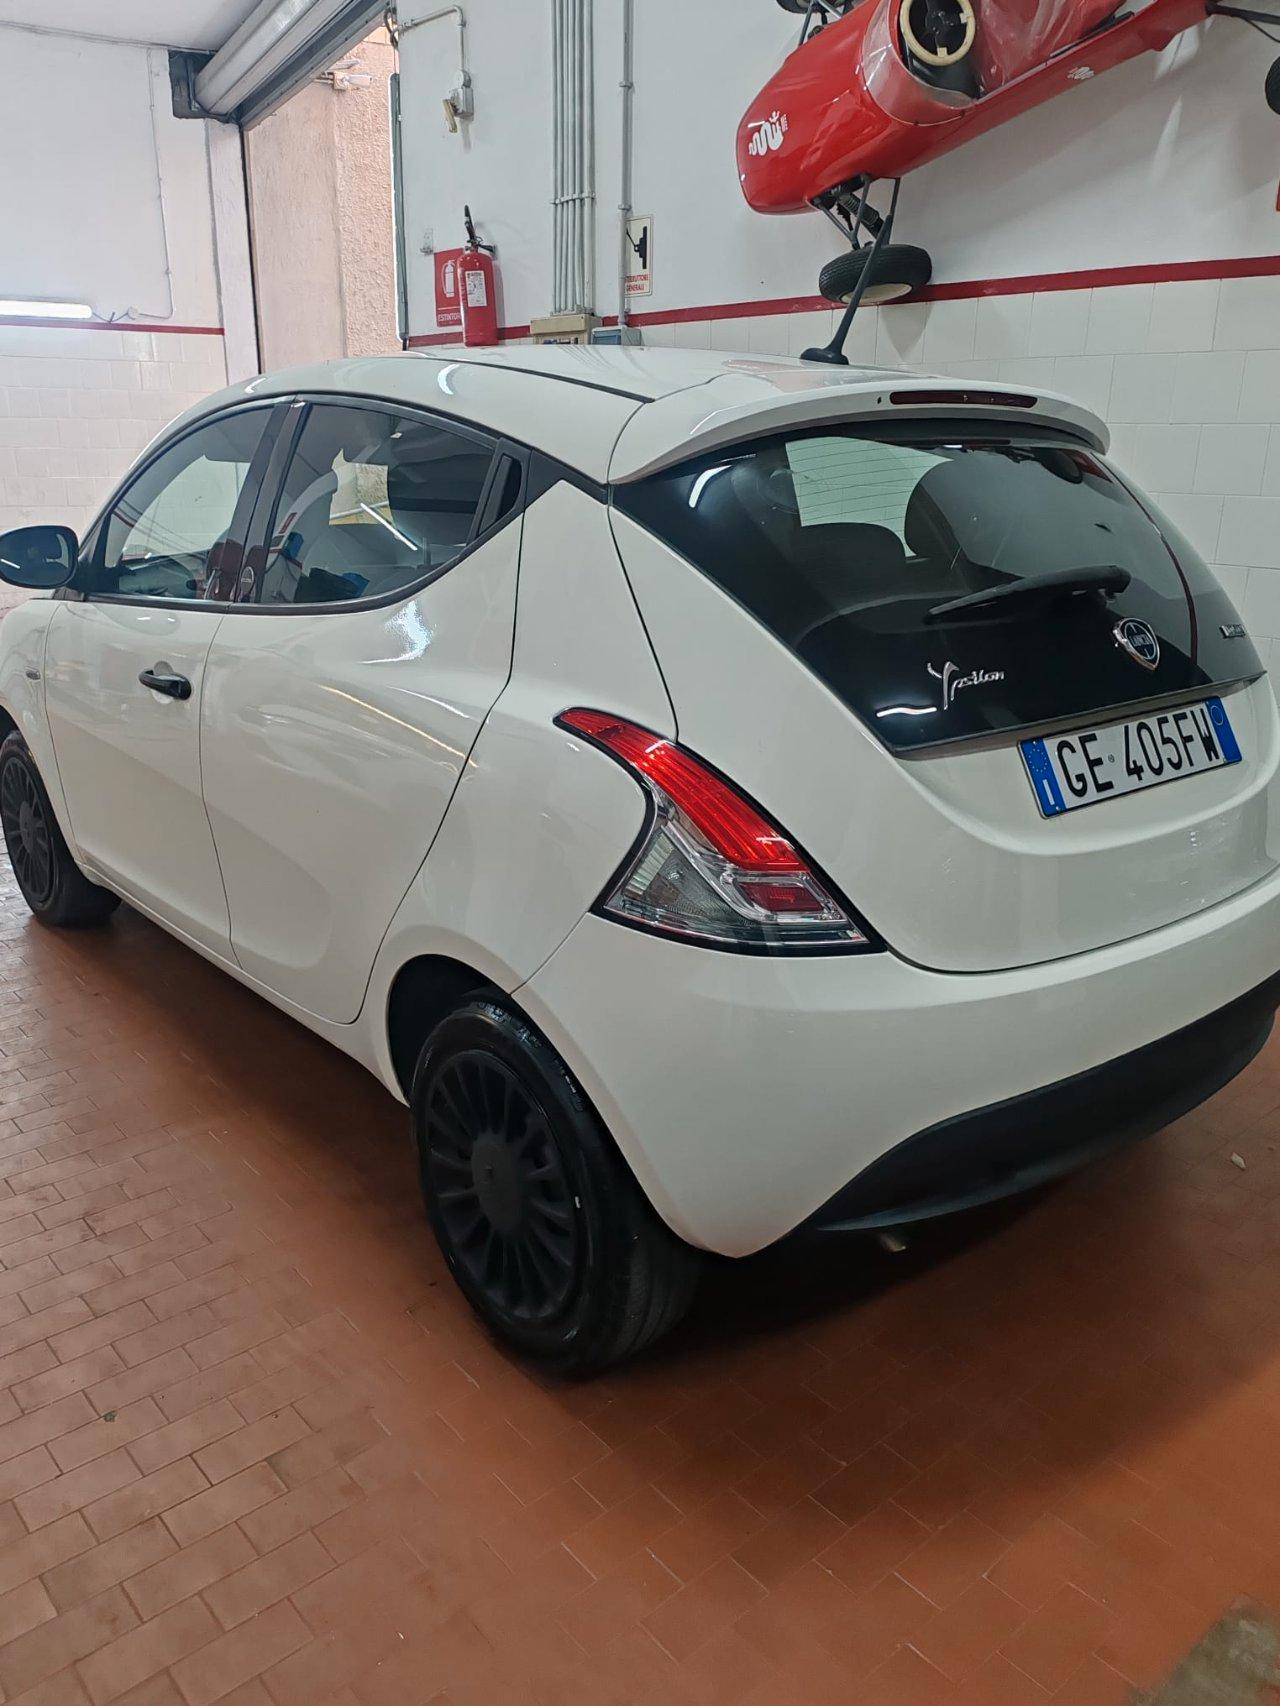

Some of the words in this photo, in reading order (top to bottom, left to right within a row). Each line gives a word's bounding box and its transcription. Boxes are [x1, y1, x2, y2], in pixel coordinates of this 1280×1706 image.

[927, 661, 1005, 710] Ypsilon
[1056, 733, 1114, 798] GE
[1123, 708, 1220, 781] 405FW
